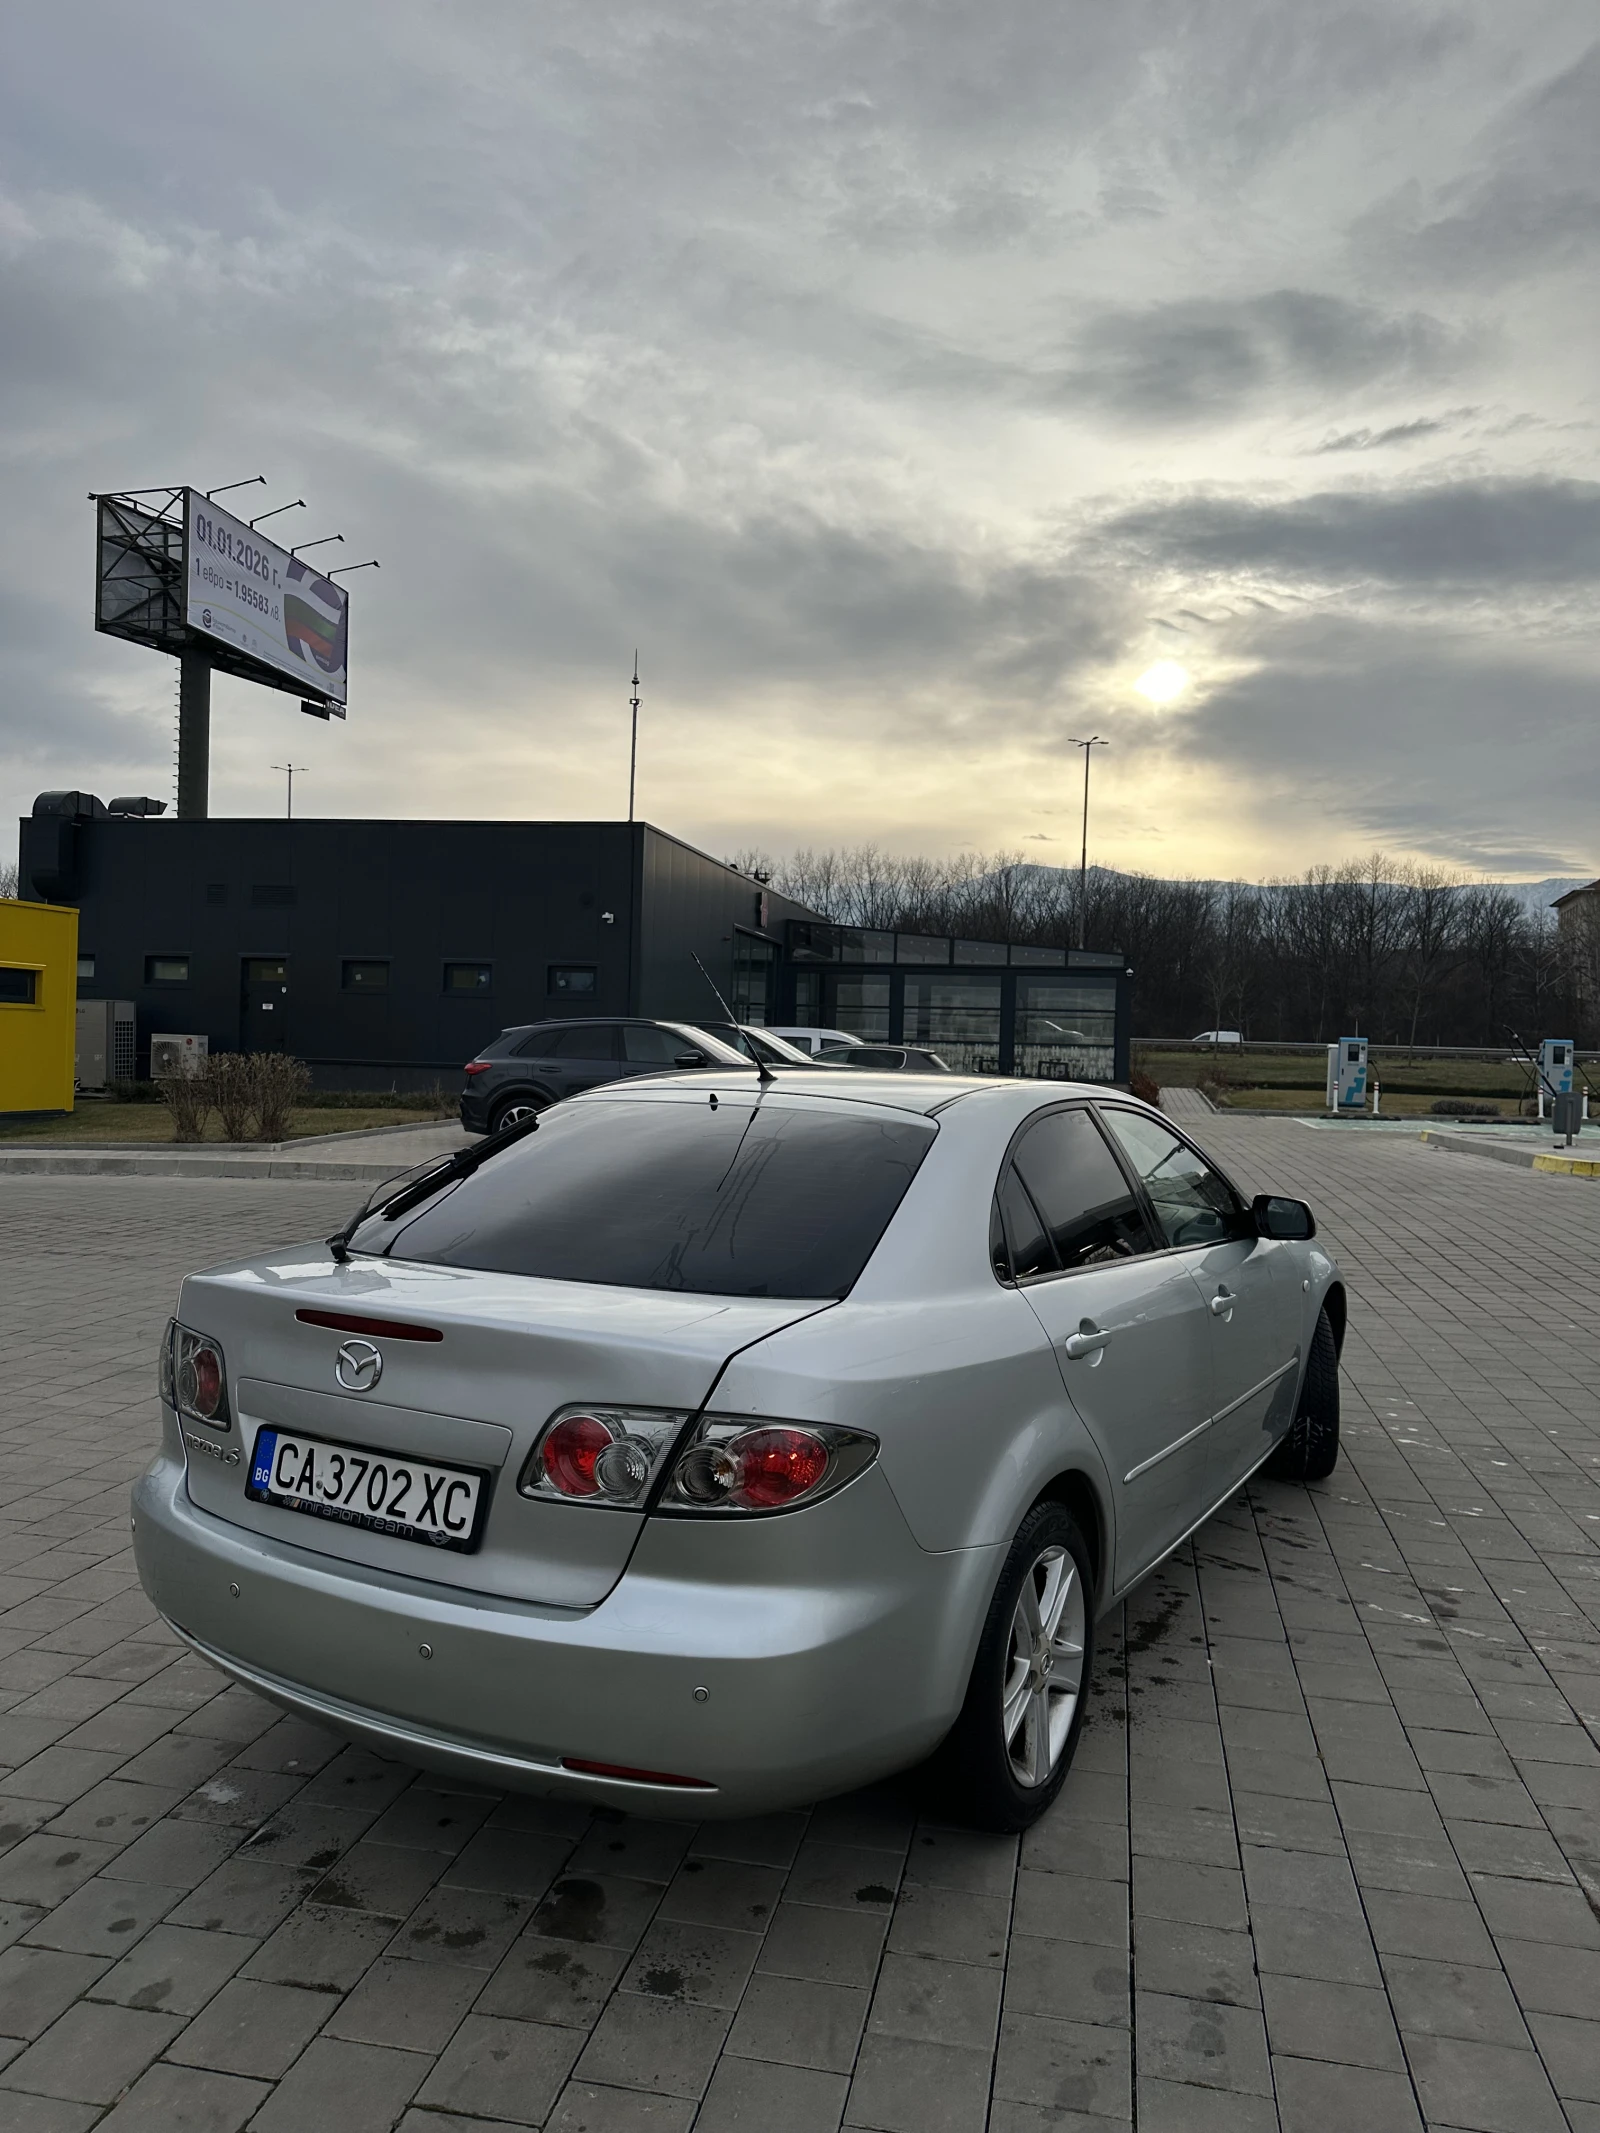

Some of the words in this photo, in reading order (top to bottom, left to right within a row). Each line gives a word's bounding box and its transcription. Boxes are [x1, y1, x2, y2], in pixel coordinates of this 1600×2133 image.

[197, 513, 269, 581] 01.01.2026
[195, 557, 200, 576] 1
[234, 580, 269, 615] 1.95583
[225, 1447, 241, 1467] 6
[254, 1467, 269, 1483] BG
[275, 1443, 315, 1496] CA
[323, 1454, 413, 1518] 3702
[415, 1473, 471, 1531] XC
